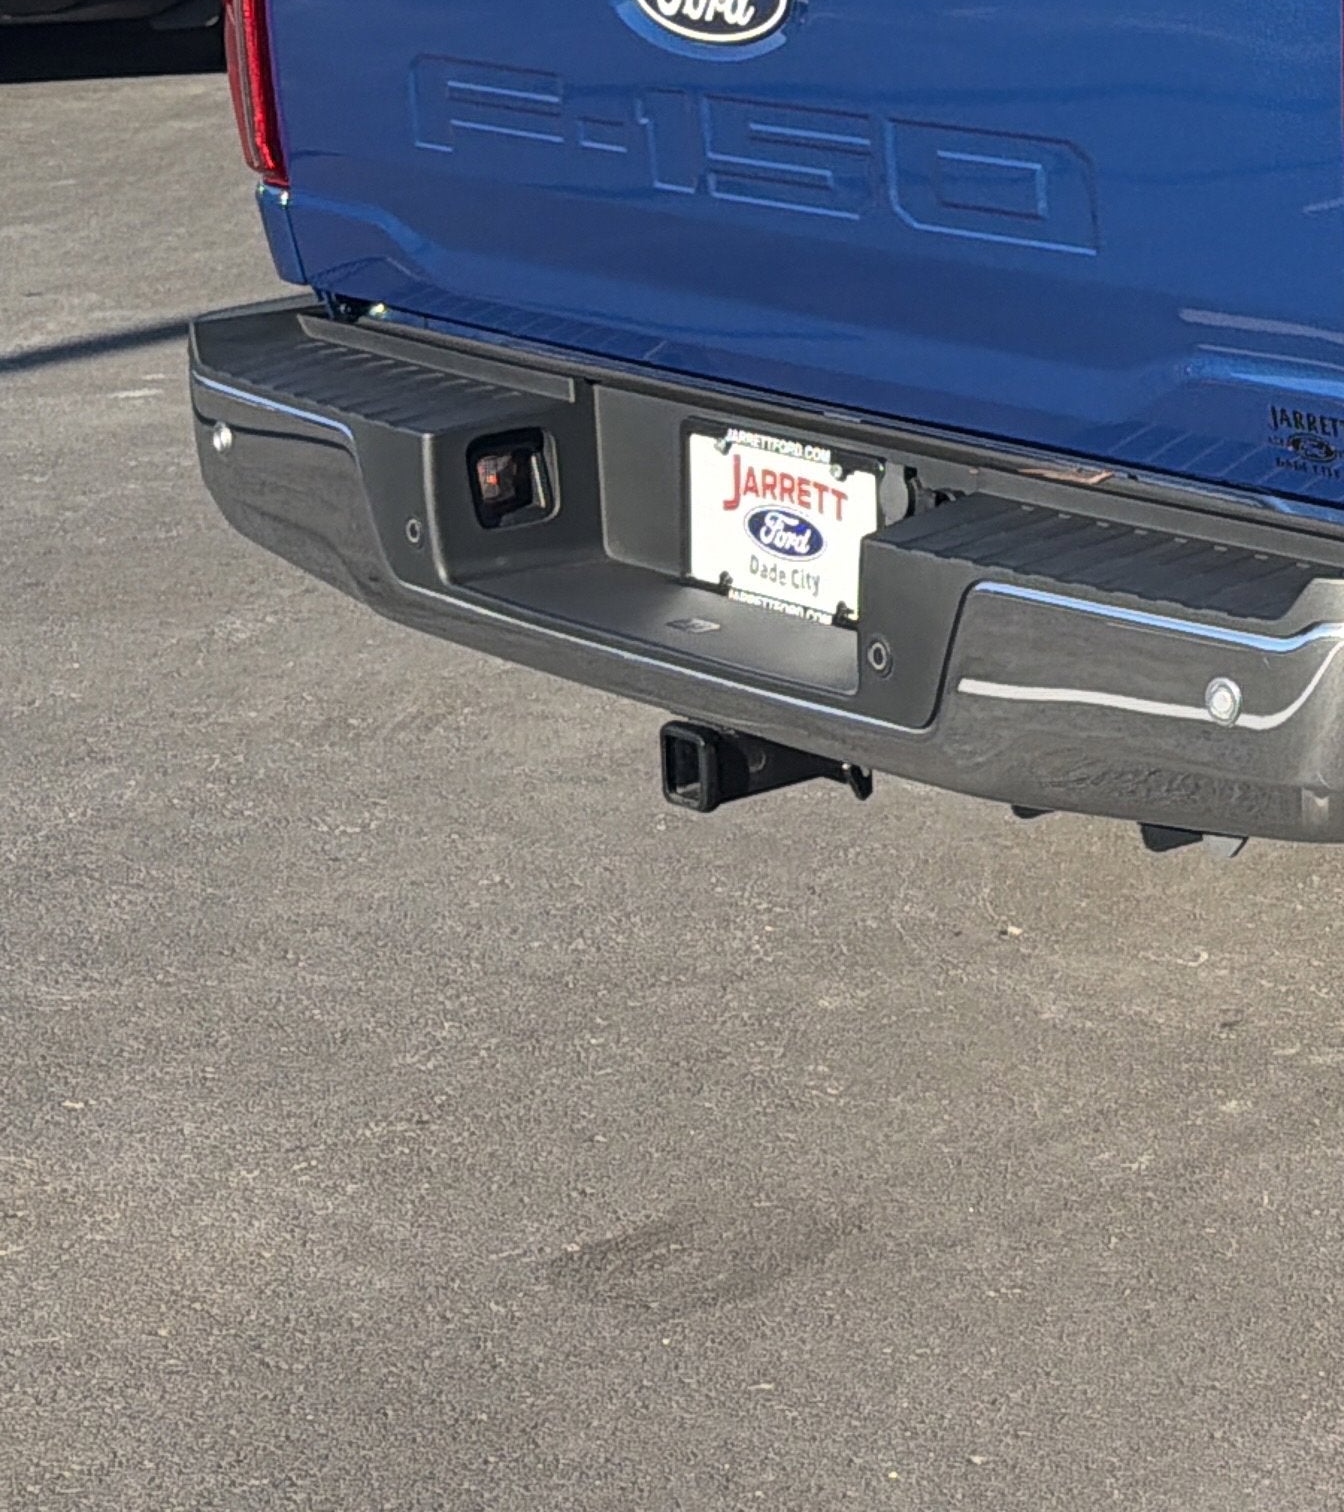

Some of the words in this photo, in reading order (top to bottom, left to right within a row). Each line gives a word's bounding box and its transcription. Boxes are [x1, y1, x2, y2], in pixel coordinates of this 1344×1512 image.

[407, 53, 1098, 256] F-150
[723, 454, 848, 521] JARRETT
[760, 512, 812, 554] Ford
[749, 554, 787, 586] Dade
[791, 569, 821, 597] City
